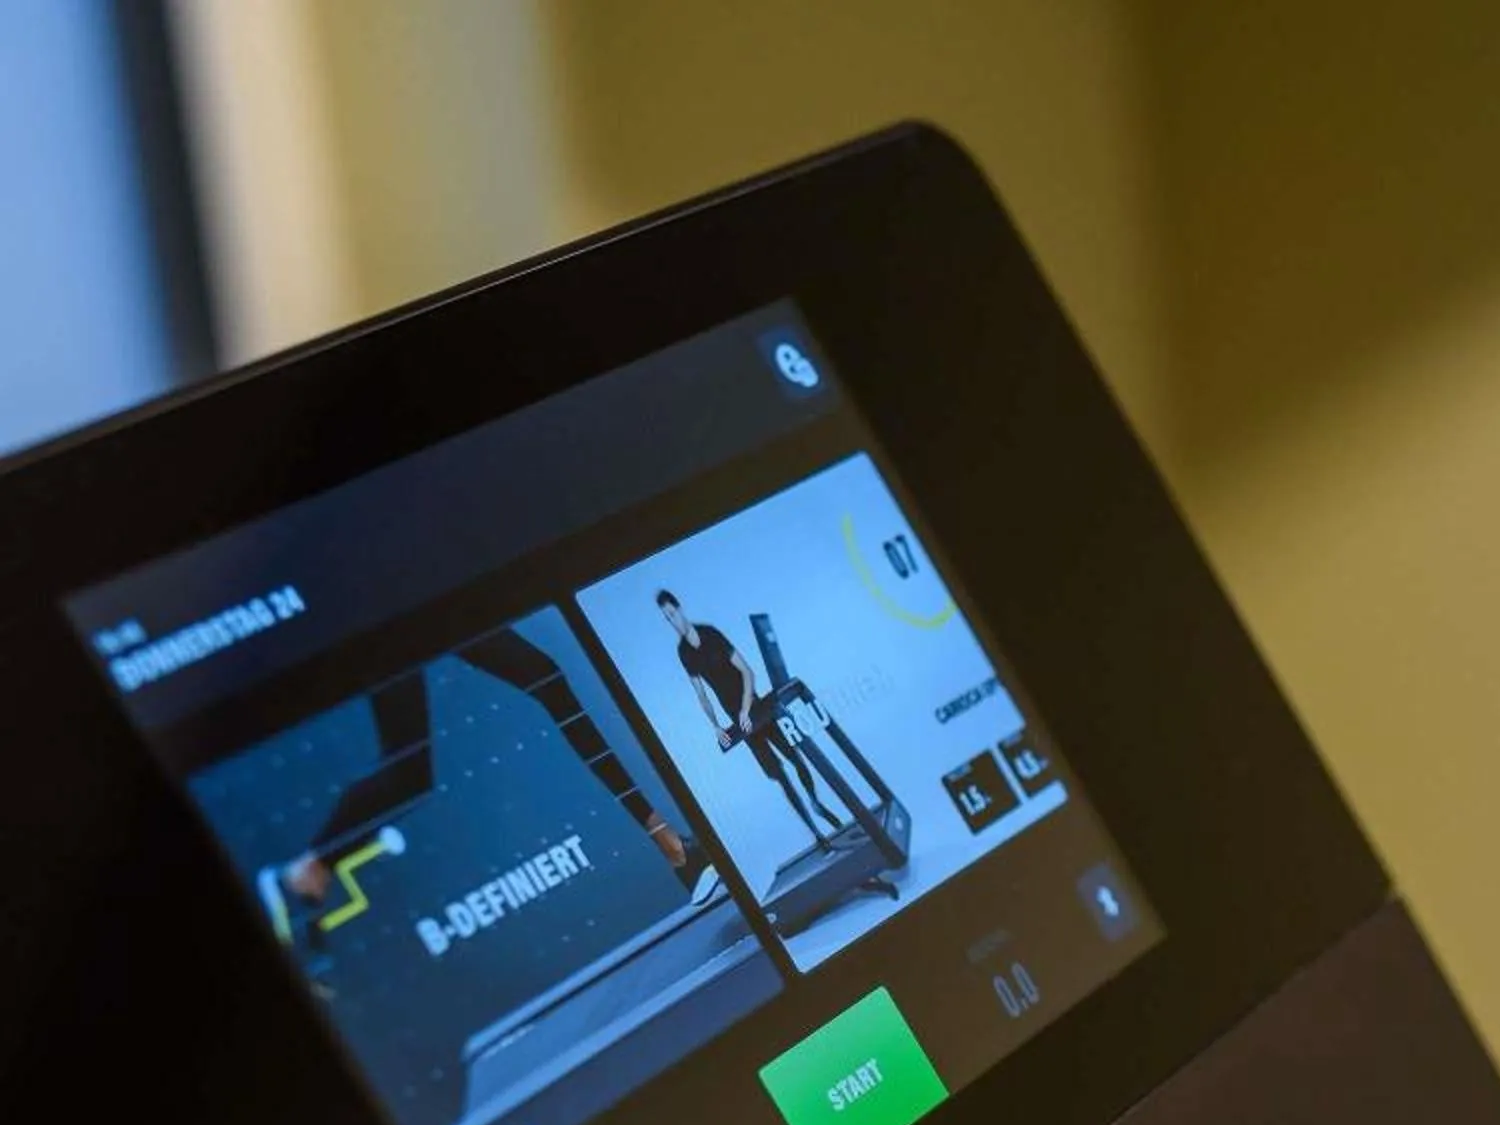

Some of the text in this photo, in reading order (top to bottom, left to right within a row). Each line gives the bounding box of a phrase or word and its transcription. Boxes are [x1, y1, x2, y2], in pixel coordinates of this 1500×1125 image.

[882, 534, 919, 580] 07
[416, 834, 592, 957] B-DEFINIERT
[993, 962, 1040, 1018] 0.0
[828, 1057, 884, 1112] START
